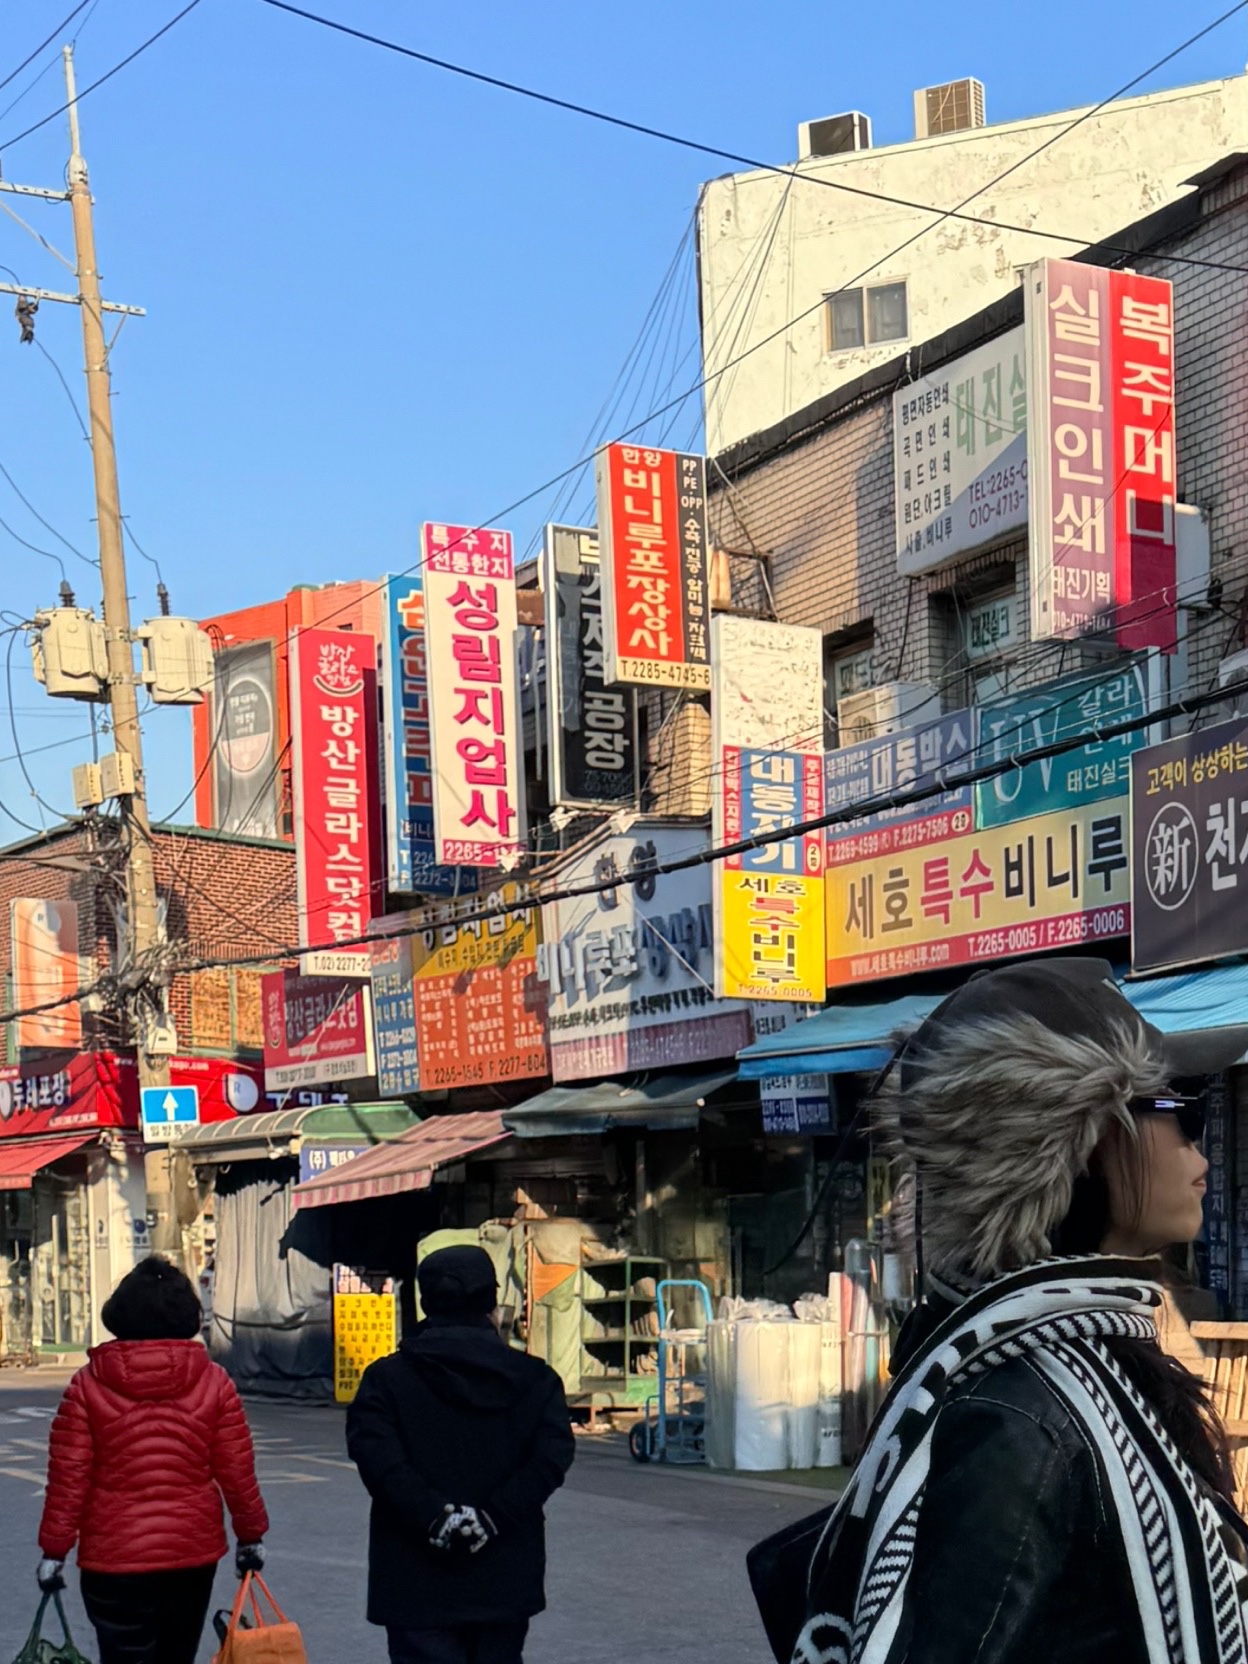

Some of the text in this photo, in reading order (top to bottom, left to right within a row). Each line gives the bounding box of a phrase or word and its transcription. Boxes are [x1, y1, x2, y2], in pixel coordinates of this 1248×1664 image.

[901, 381, 950, 427] 평면자동인쇄
[1049, 284, 1107, 555] 실크인쇄
[1118, 294, 1175, 546] 복주머니
[902, 414, 951, 459] 곡면인쇄
[683, 458, 697, 474] PP
[683, 475, 698, 490] PE
[903, 449, 951, 492] 패드인쇄
[681, 494, 702, 509] OPP
[432, 553, 509, 578] 전통한지
[622, 467, 674, 657] 비니루포장상사
[1052, 565, 1111, 604] 태진기획
[446, 580, 518, 839] 성림지업사
[1146, 757, 1188, 796] 고객이
[320, 704, 364, 944] 방산글라스닷컴
[844, 815, 1128, 940] 세호특수비니루
[1151, 815, 1192, 896] 新
[739, 877, 807, 896] 세호
[750, 896, 801, 984] 특수비니루
[967, 927, 1037, 958] T.2265-0005
[1047, 908, 1125, 944] F.2265-0006
